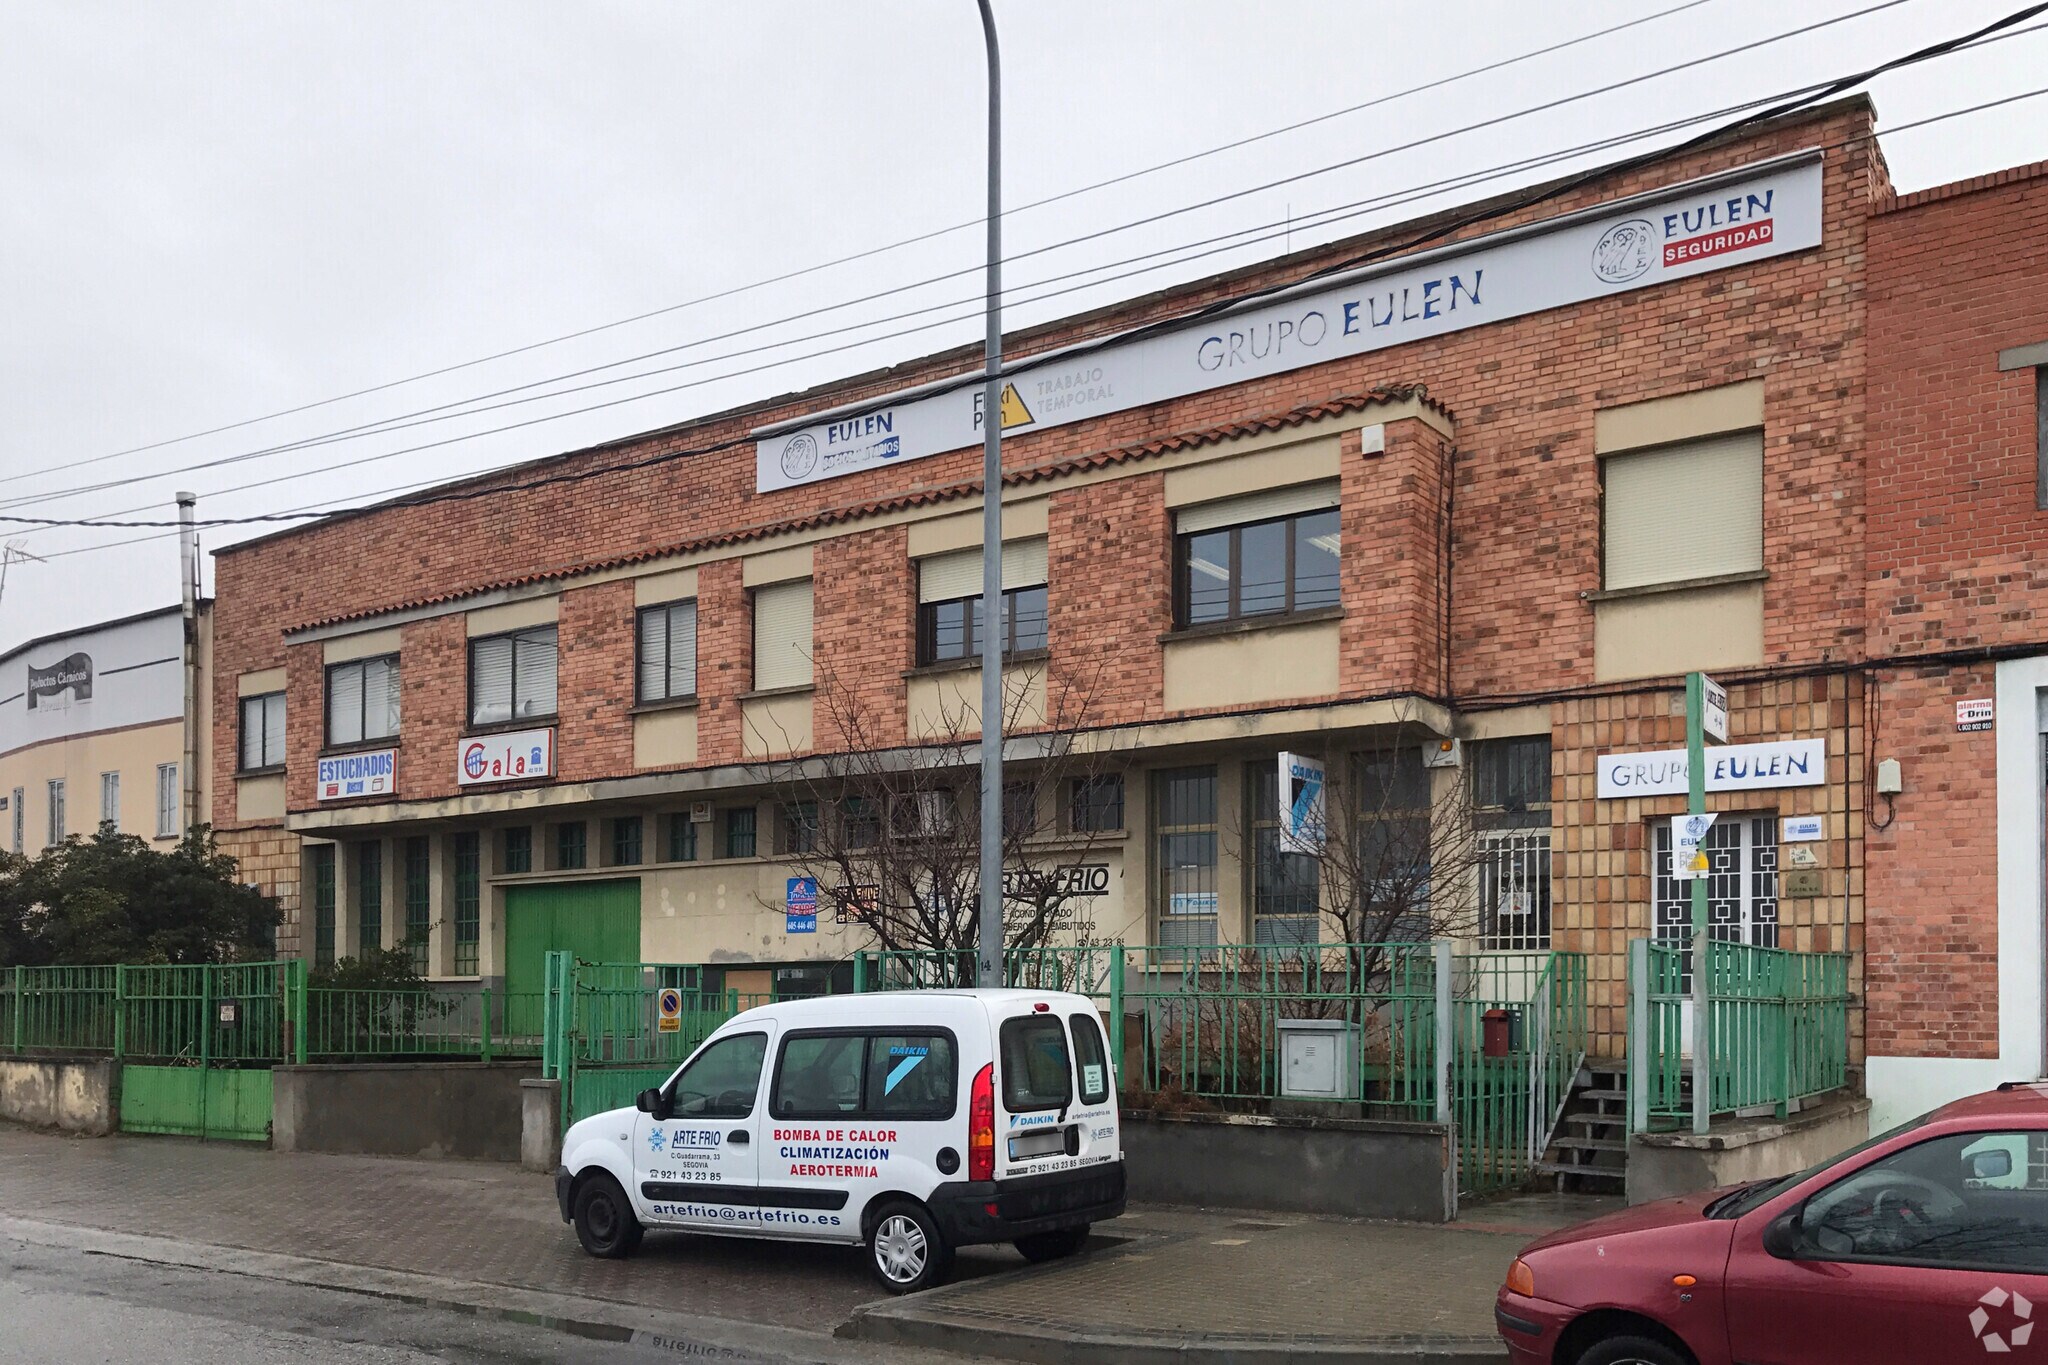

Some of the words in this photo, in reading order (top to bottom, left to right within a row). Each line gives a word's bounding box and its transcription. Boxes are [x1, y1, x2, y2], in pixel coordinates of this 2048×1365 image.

[1663, 190, 1773, 238] EULEN
[1665, 225, 1772, 262] SEGURIDAD
[1197, 311, 1327, 371] GRUPO
[1343, 269, 1483, 337] EULEN
[1037, 368, 1103, 396] TRABAJO
[1037, 384, 1115, 413] TEMPORAL
[828, 412, 892, 446] EULEN
[1958, 702, 1992, 710] alarma
[1968, 710, 1991, 718] Drin
[319, 753, 393, 783] ESTUCHADOS
[1291, 764, 1323, 781] DAIKIN
[1714, 751, 1809, 780] EULEN
[890, 1046, 928, 1055] DAIKIN
[1020, 1115, 1054, 1126] DAIKIN
[673, 1130, 697, 1145] ARTE
[699, 1131, 721, 1146] FRIO
[773, 1129, 821, 1141] BOMBA
[826, 1129, 844, 1141] DE
[849, 1130, 897, 1142] CALOR
[780, 1146, 889, 1160] CLIMATIZACIÓN
[683, 1161, 709, 1169] SEGOVIA
[790, 1164, 878, 1178] AEROTERMIA
[1038, 1164, 1049, 1172] 921
[1052, 1162, 1059, 1170] 43
[1070, 1159, 1077, 1167] 85
[1079, 1156, 1098, 1166] SEGOVIA
[661, 1170, 676, 1179] 921
[681, 1171, 692, 1180] 43
[695, 1171, 706, 1180] 23
[710, 1172, 721, 1181] 85
[653, 1204, 841, 1226] artefrio@artefrio.es
